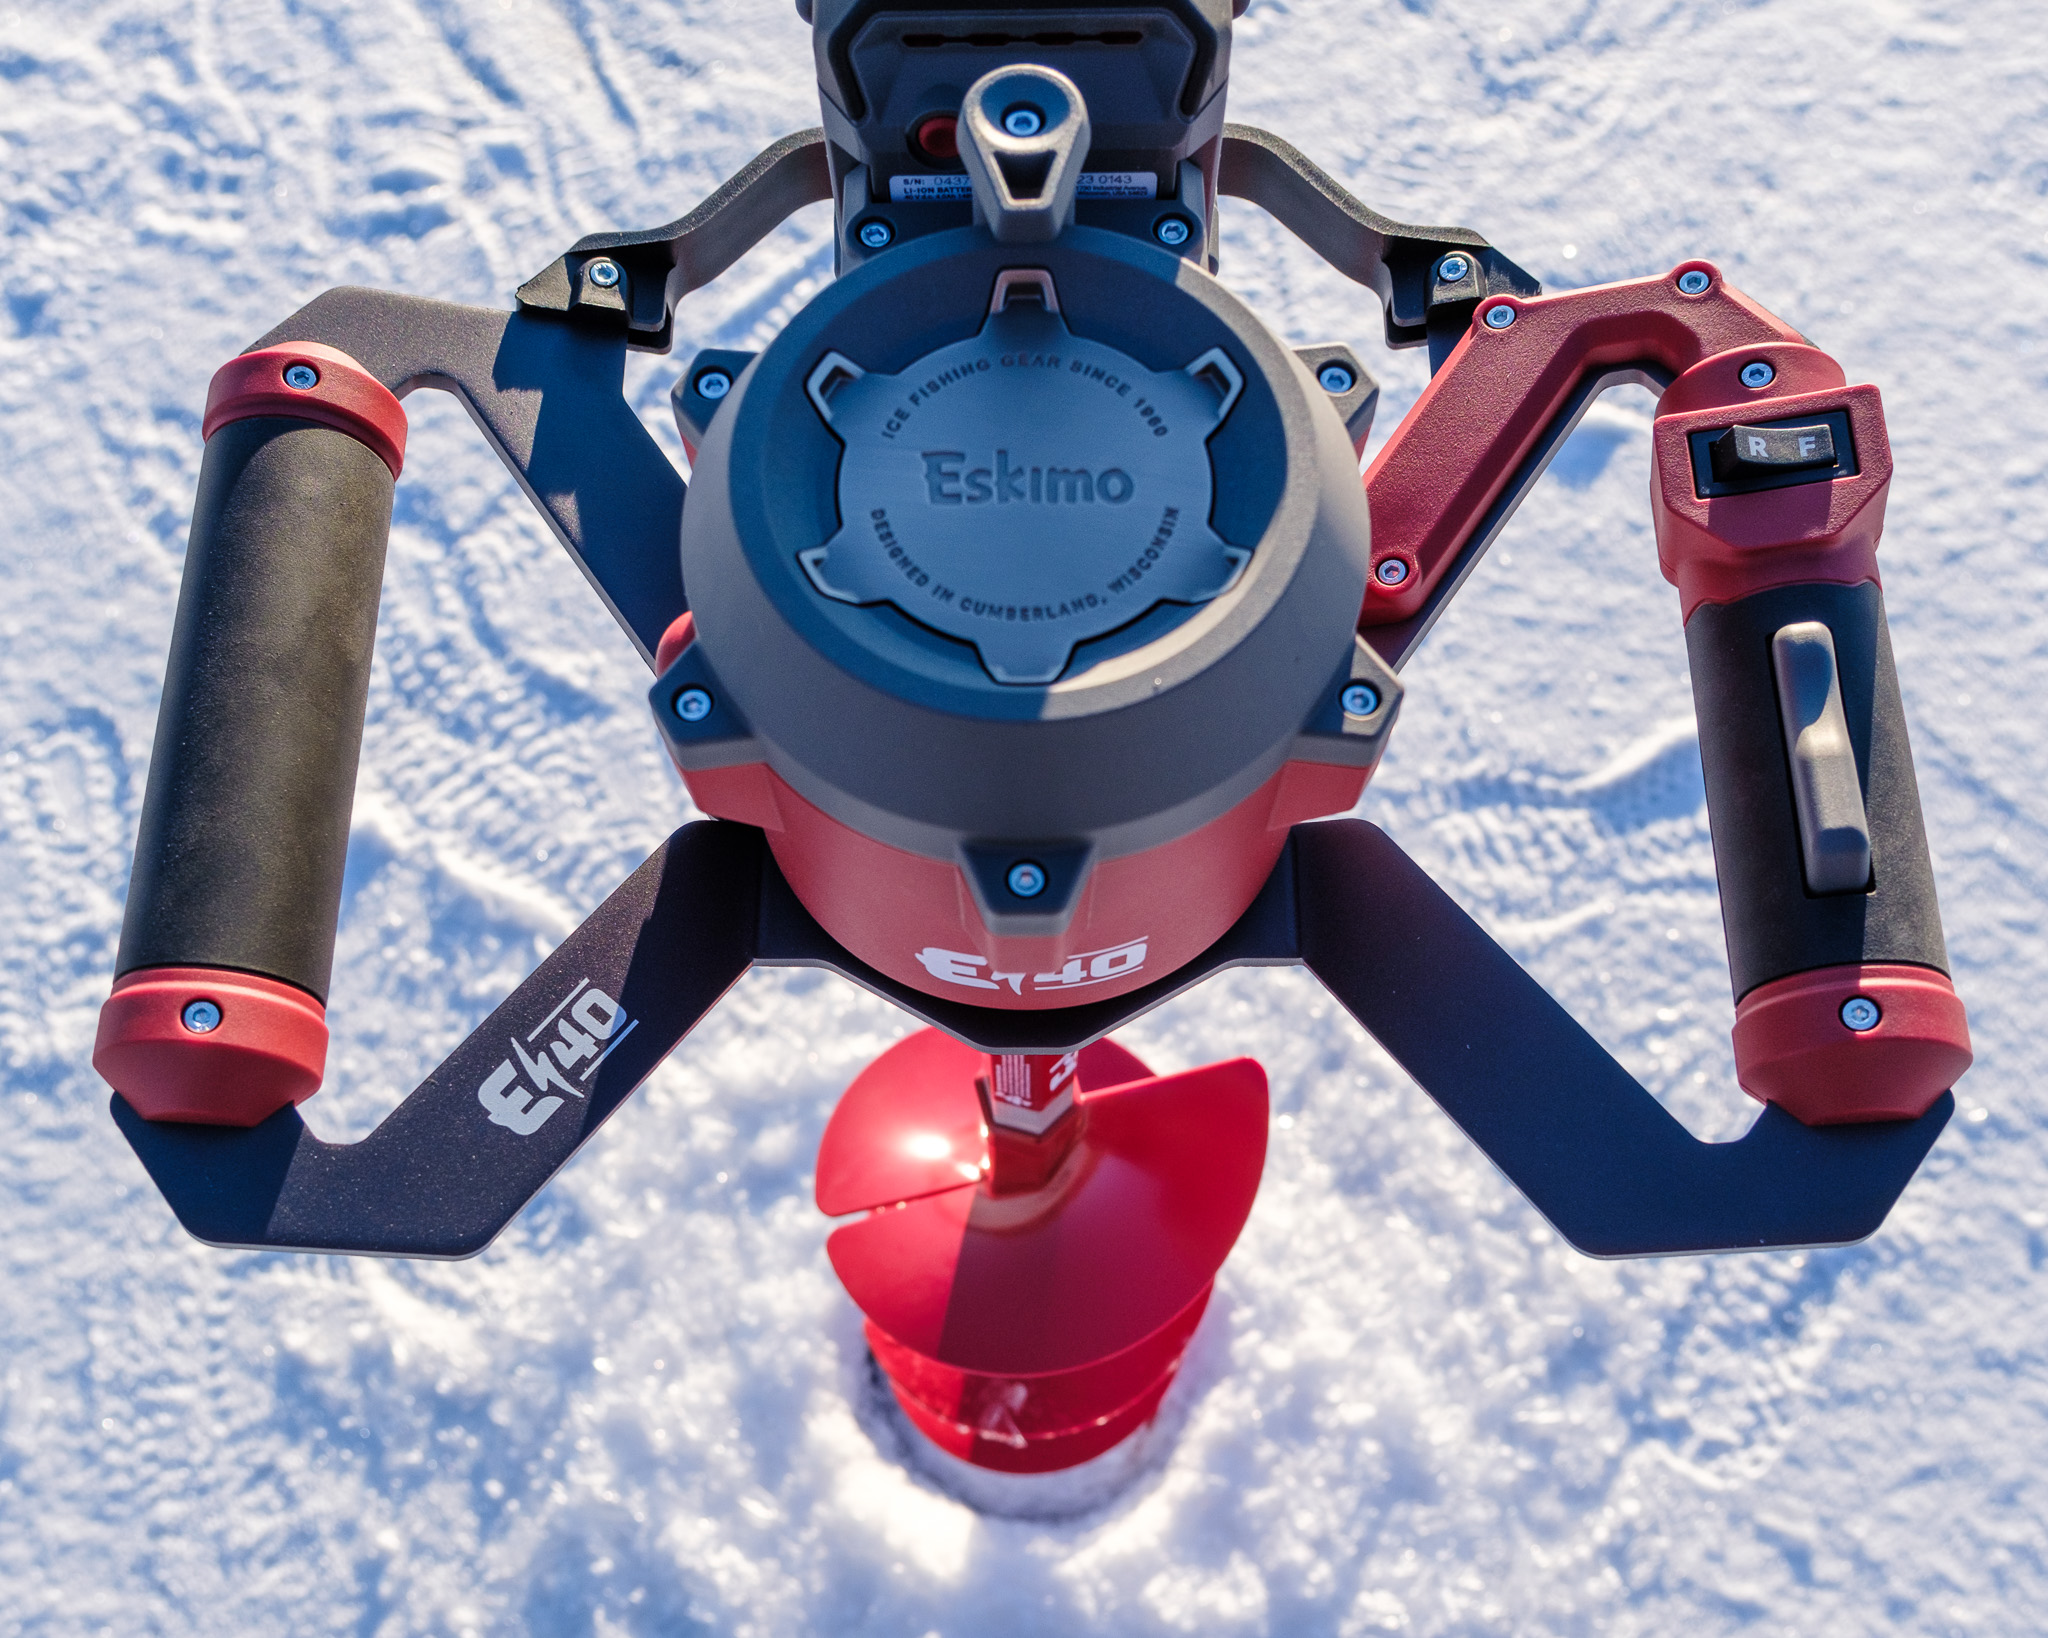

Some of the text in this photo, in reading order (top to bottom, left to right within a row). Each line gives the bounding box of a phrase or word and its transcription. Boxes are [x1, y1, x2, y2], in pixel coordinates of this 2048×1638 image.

[903, 178, 925, 186] S/N:
[1098, 174, 1132, 185] 0143
[937, 186, 973, 194] BATTER
[882, 408, 910, 439] ICE
[909, 358, 990, 406] FISHING
[1001, 353, 1061, 369] GEAR
[1069, 359, 1132, 397] SINCE
[1749, 436, 1769, 458] R
[1798, 436, 1816, 458] F
[922, 450, 1134, 504] Eskimo
[871, 506, 1179, 622] DESIGNED IN CUMBERLAND, WISCONSIN
